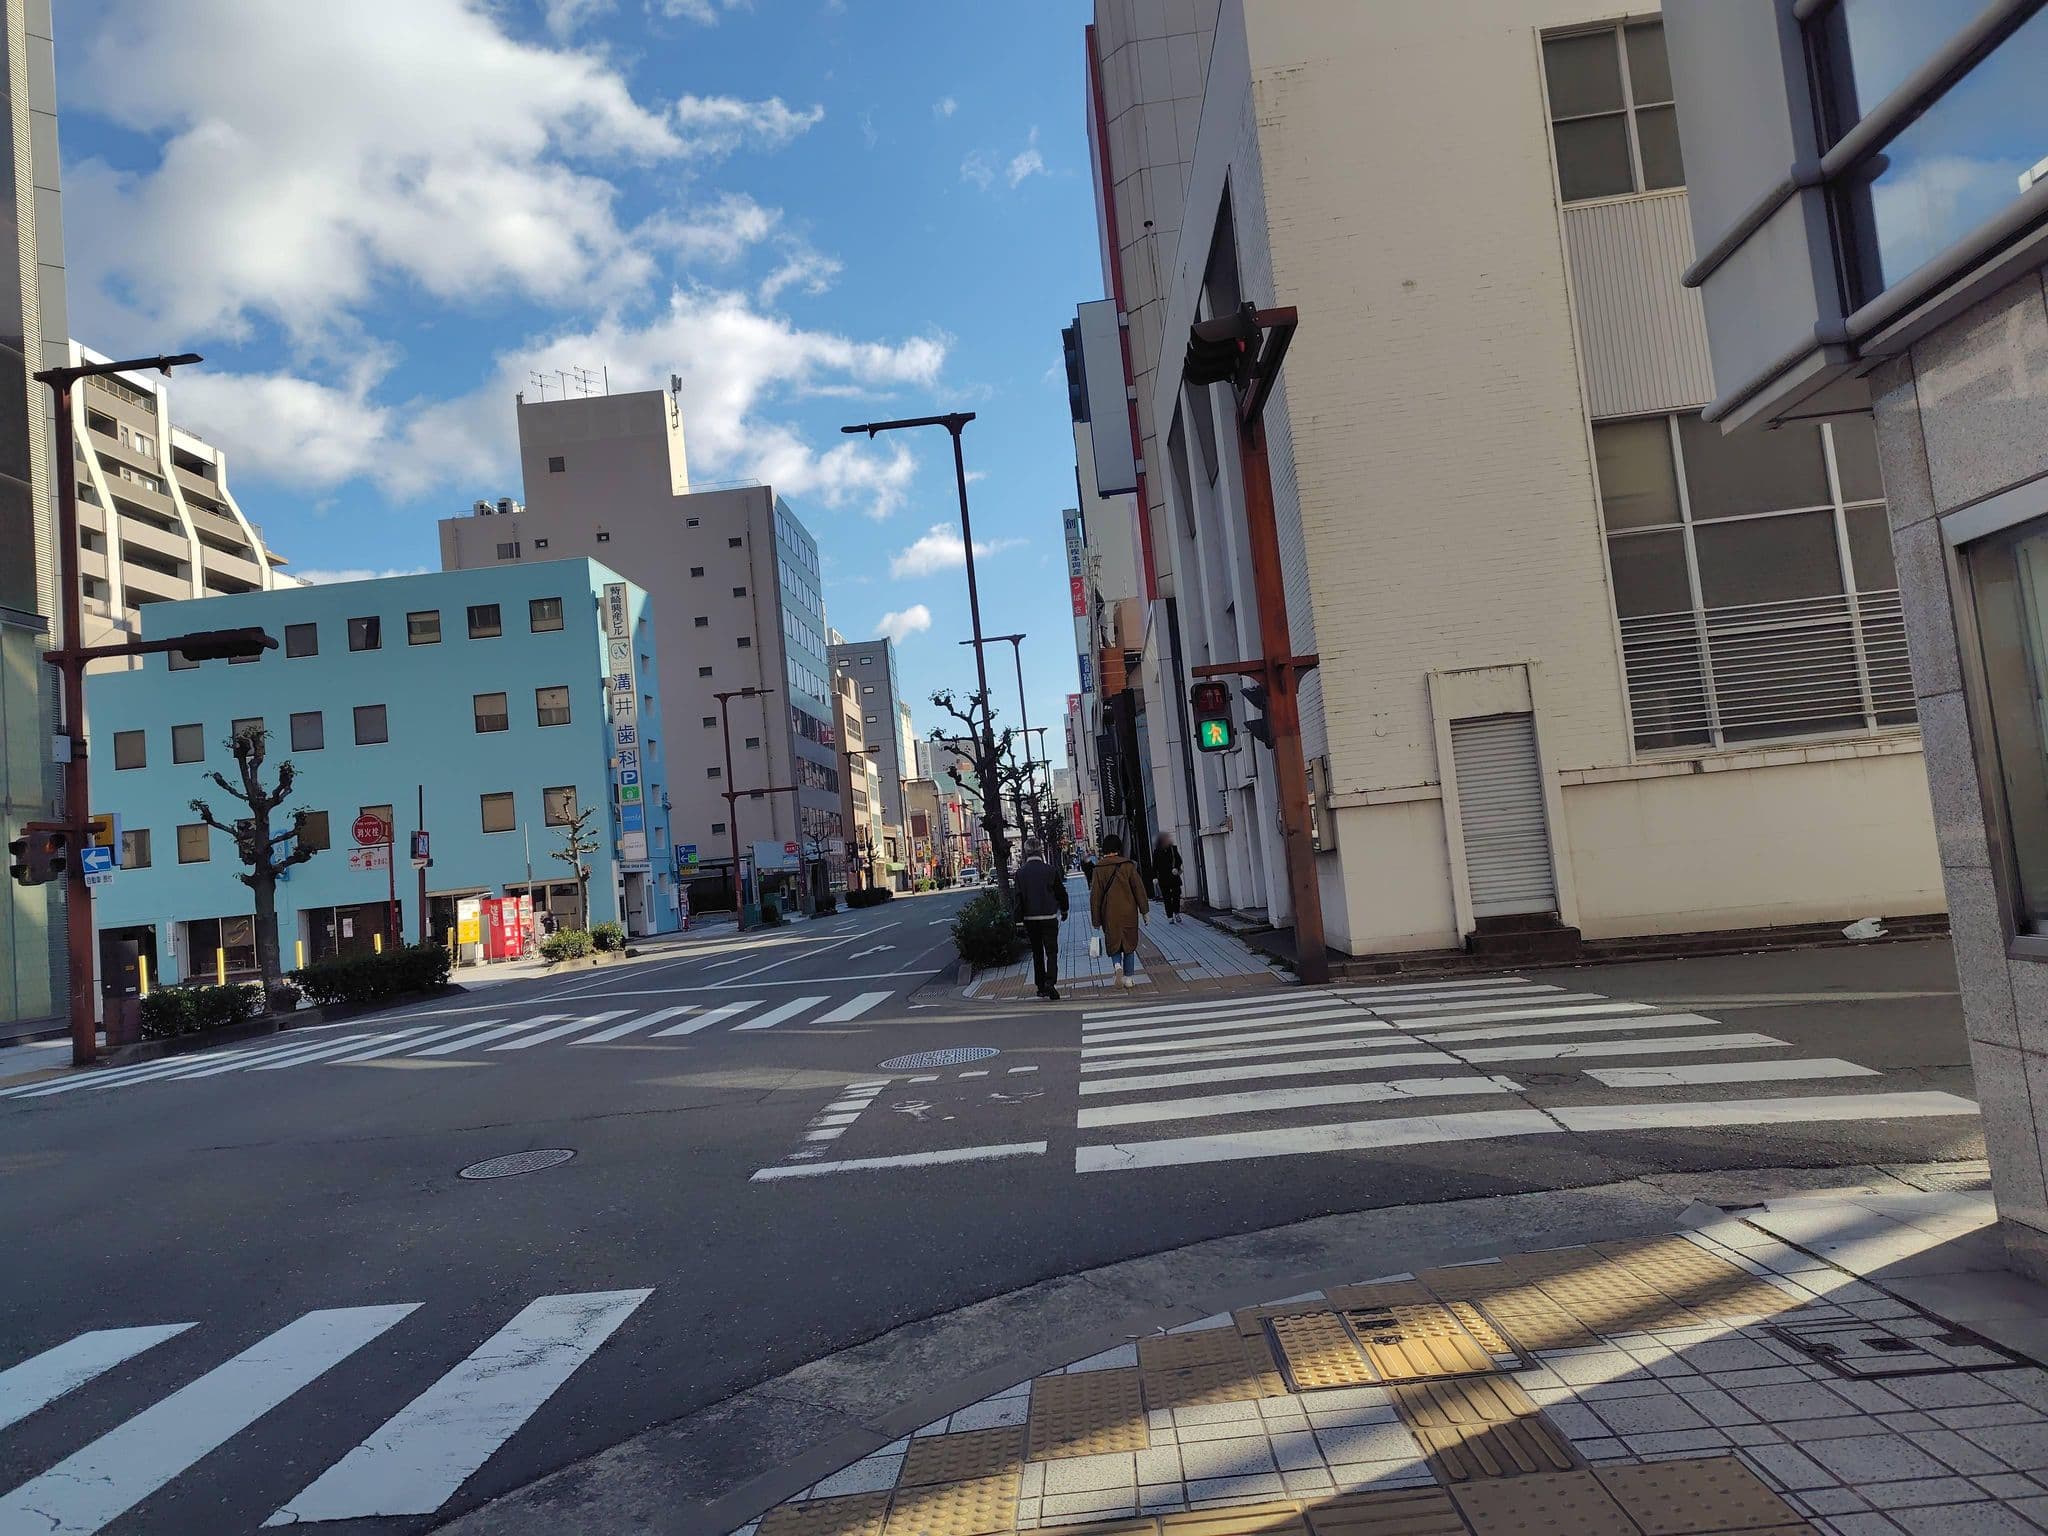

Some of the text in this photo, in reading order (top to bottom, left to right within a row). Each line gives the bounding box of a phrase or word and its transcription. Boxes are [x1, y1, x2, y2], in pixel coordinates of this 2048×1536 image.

[613, 673, 638, 768] 溝井歯科
[357, 827, 379, 838] 消火栓
